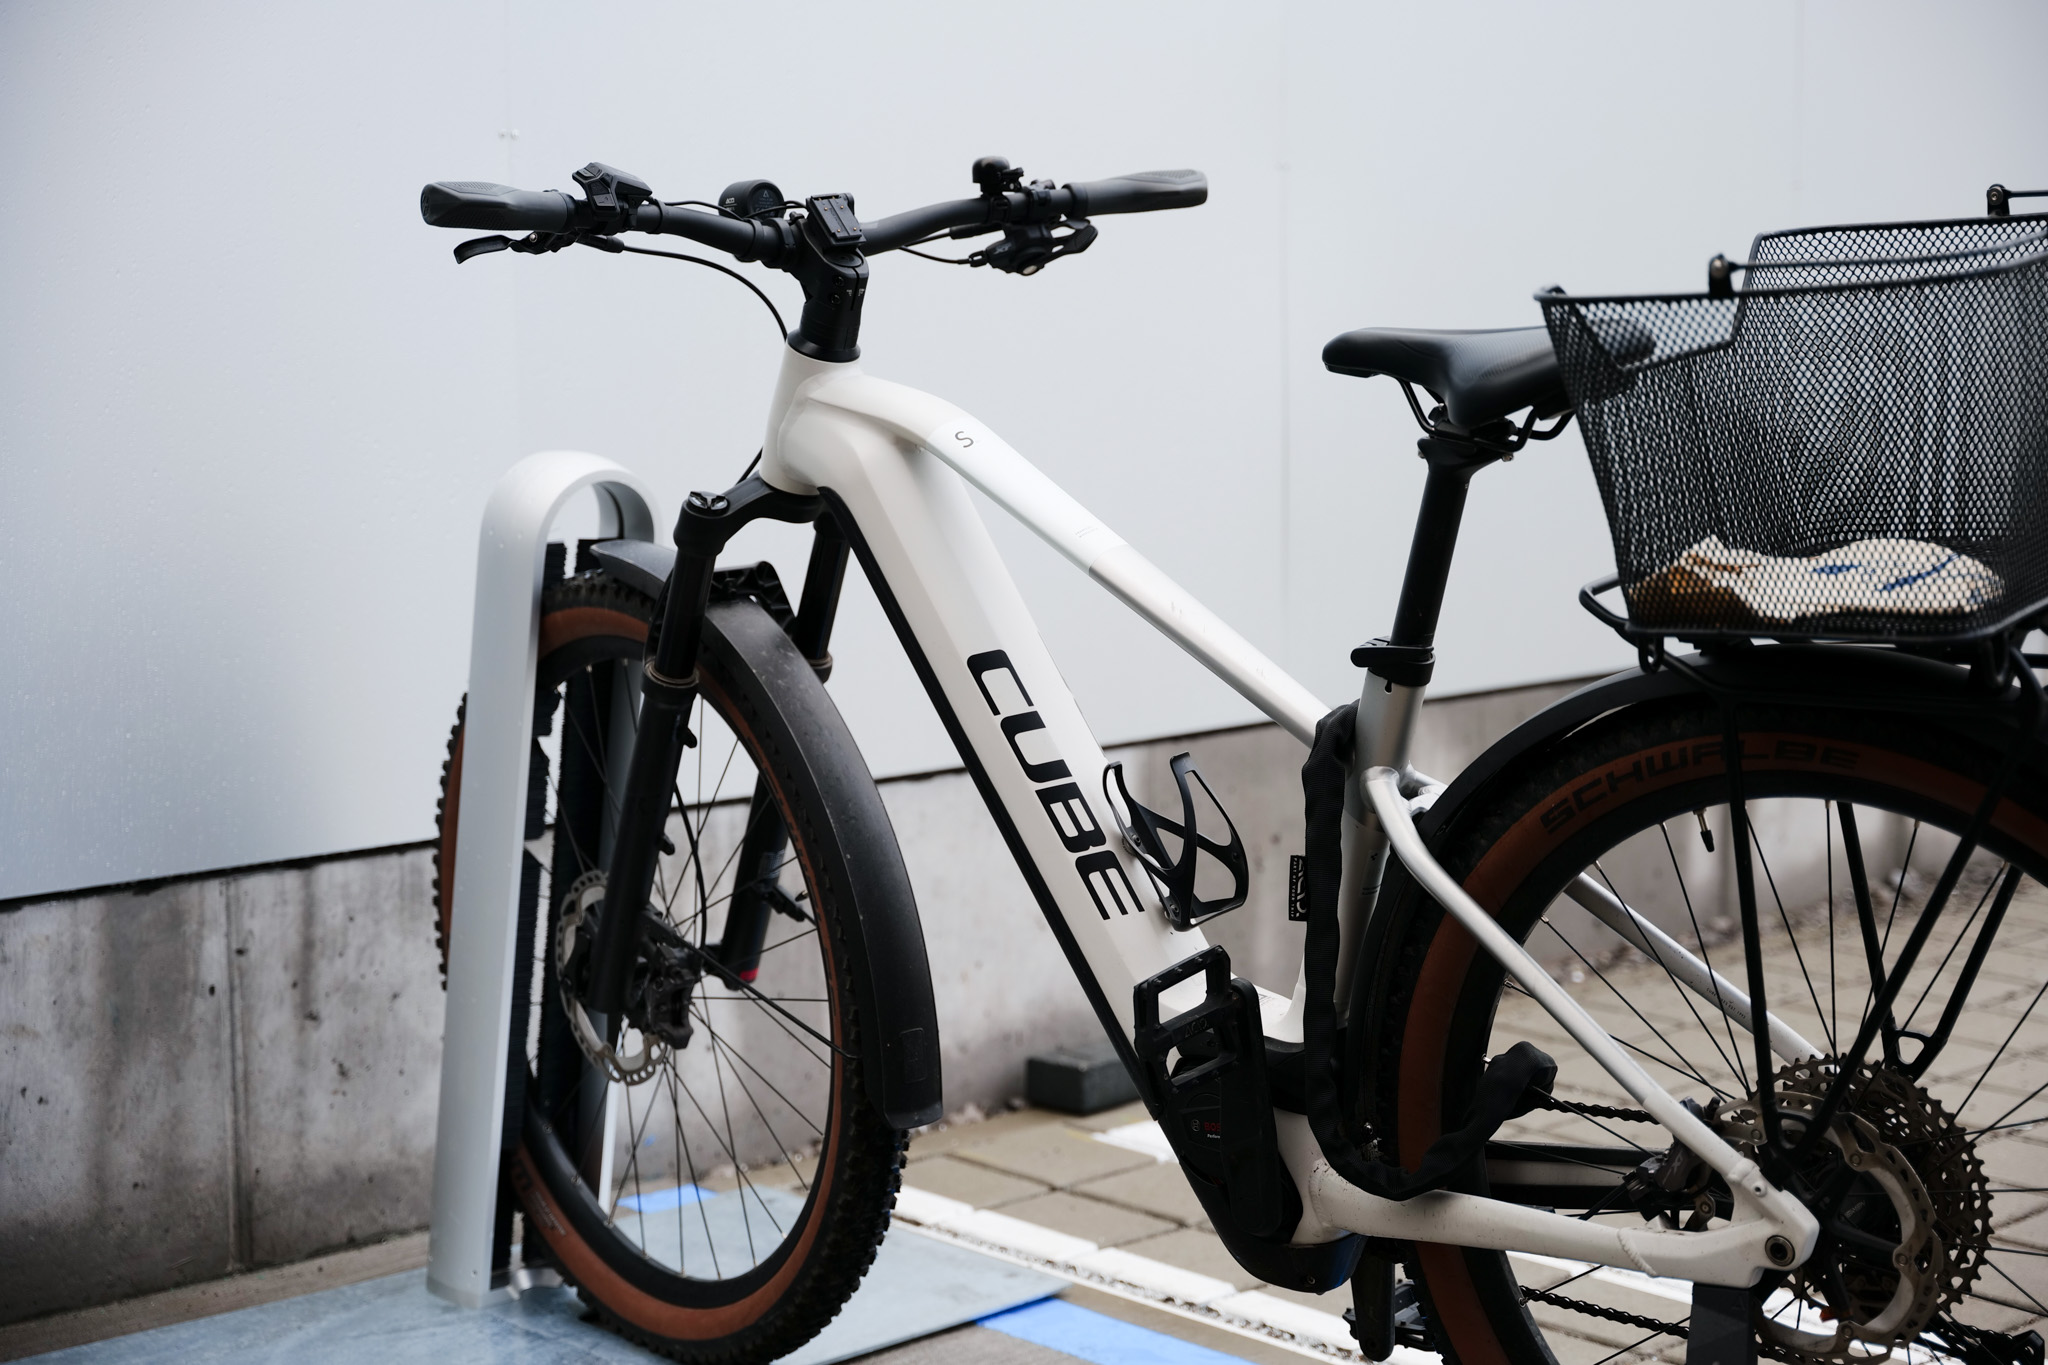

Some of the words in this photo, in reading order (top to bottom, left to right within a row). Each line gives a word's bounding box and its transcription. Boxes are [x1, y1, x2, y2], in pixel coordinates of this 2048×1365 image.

[955, 431, 974, 448] S
[966, 649, 1145, 920] CUBE
[1540, 739, 1861, 834] SCHWALBE
